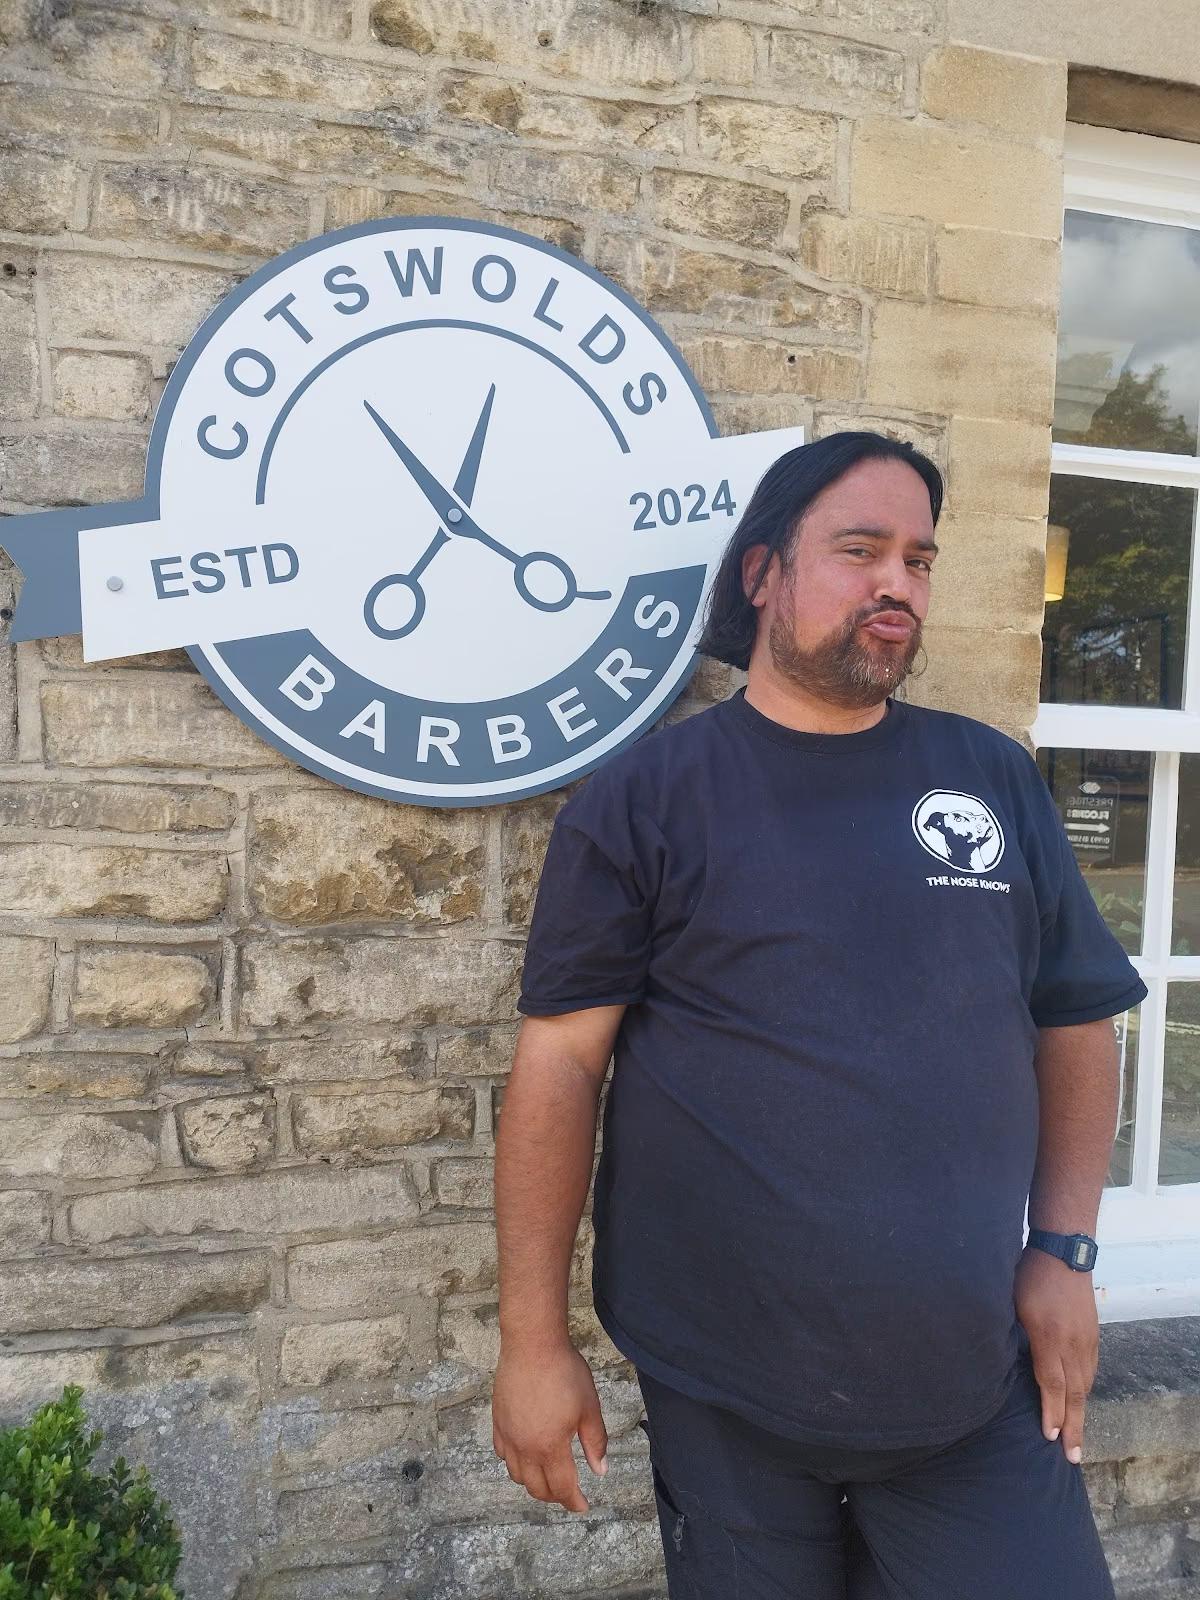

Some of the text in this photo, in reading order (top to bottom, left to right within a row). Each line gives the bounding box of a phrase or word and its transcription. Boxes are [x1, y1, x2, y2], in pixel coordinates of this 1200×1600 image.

[196, 244, 667, 460] COTSWOLDS
[149, 479, 736, 600] ESTD 2024
[277, 594, 680, 768] BARBERS
[925, 875, 1011, 894] THE NOSE KNOWS
